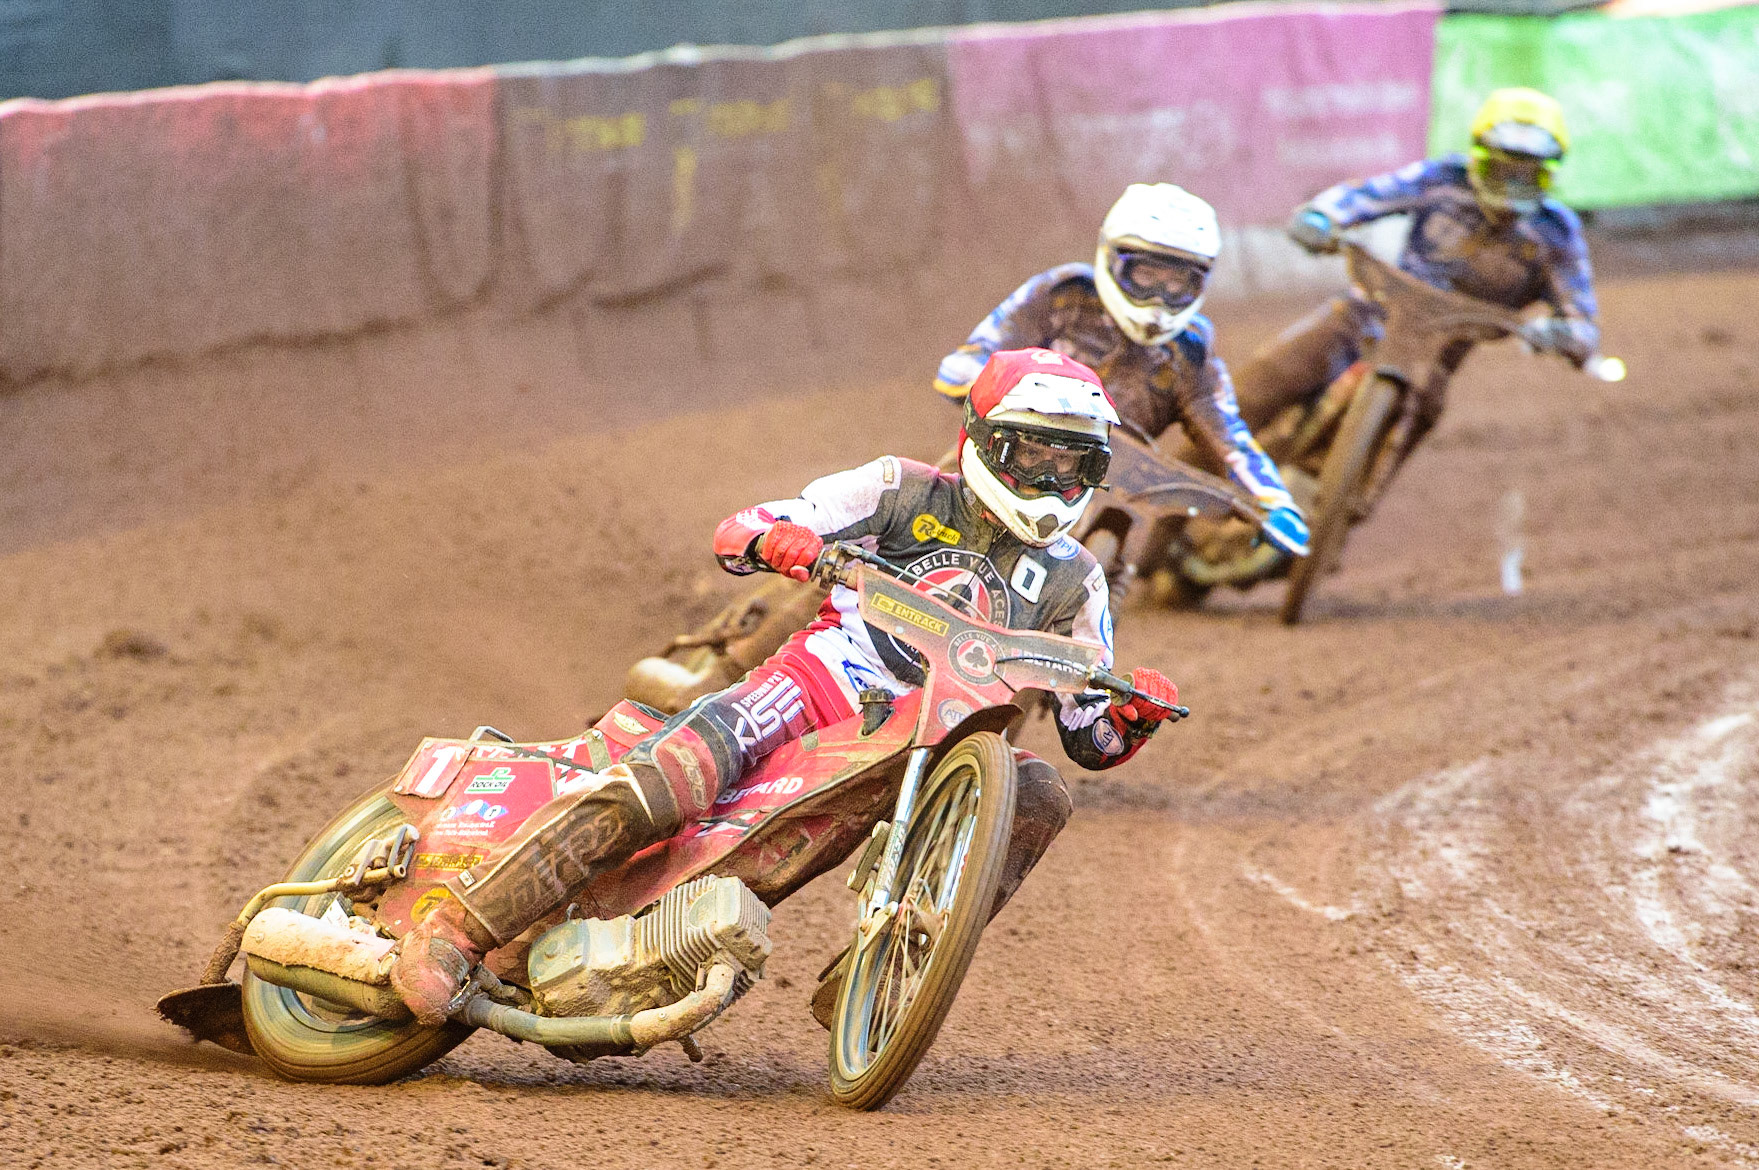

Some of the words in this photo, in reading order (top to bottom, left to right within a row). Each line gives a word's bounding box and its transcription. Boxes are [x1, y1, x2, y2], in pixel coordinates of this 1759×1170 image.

[911, 553, 960, 576] BELLE
[969, 556, 995, 584] VUE
[990, 589, 1005, 627] ACES
[895, 604, 943, 631] ENTRACK
[954, 632, 973, 647] BELLE
[976, 633, 991, 643] VUE
[414, 745, 456, 794] 1
